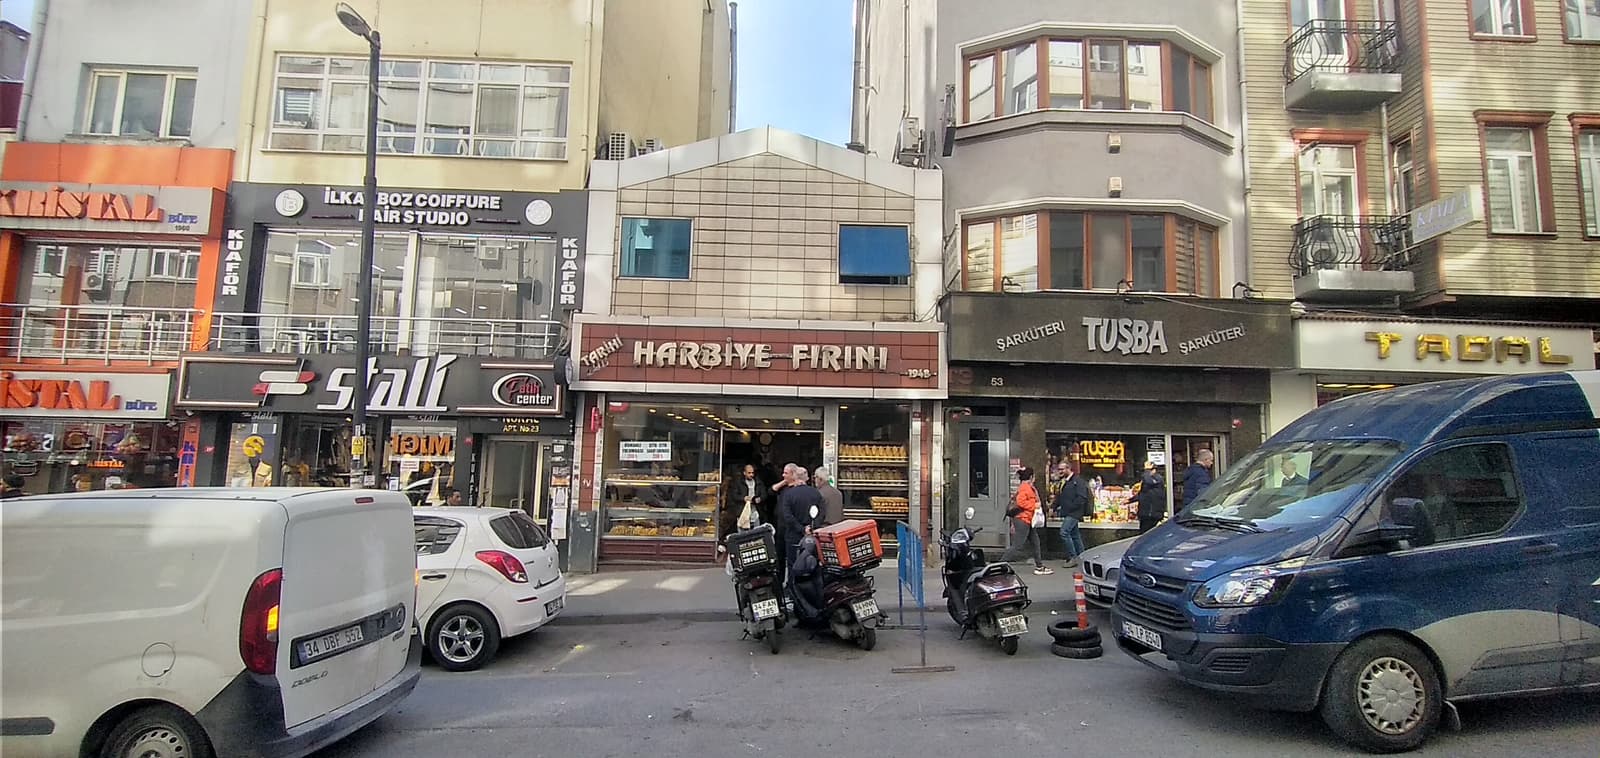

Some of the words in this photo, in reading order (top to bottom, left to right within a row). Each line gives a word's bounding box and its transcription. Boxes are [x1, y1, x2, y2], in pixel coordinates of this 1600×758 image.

[324, 187, 366, 205] İLKA
[377, 192, 412, 207] BOZ
[415, 194, 501, 210] COIFFURE
[403, 211, 470, 226] STUDIO
[222, 229, 244, 296] KUAFÖR
[559, 238, 578, 305] KUAFÖR
[1082, 316, 1168, 355] TUŞBA
[1365, 331, 1574, 364] TADAL
[633, 337, 772, 370] HARBİYE
[792, 344, 888, 372] FIRINI
[991, 377, 1004, 387] 53
[516, 393, 553, 405] center
[1080, 440, 1125, 458] TUŞBA
[305, 641, 320, 657] 34
[324, 635, 340, 651] DBF
[346, 627, 362, 643] 552
